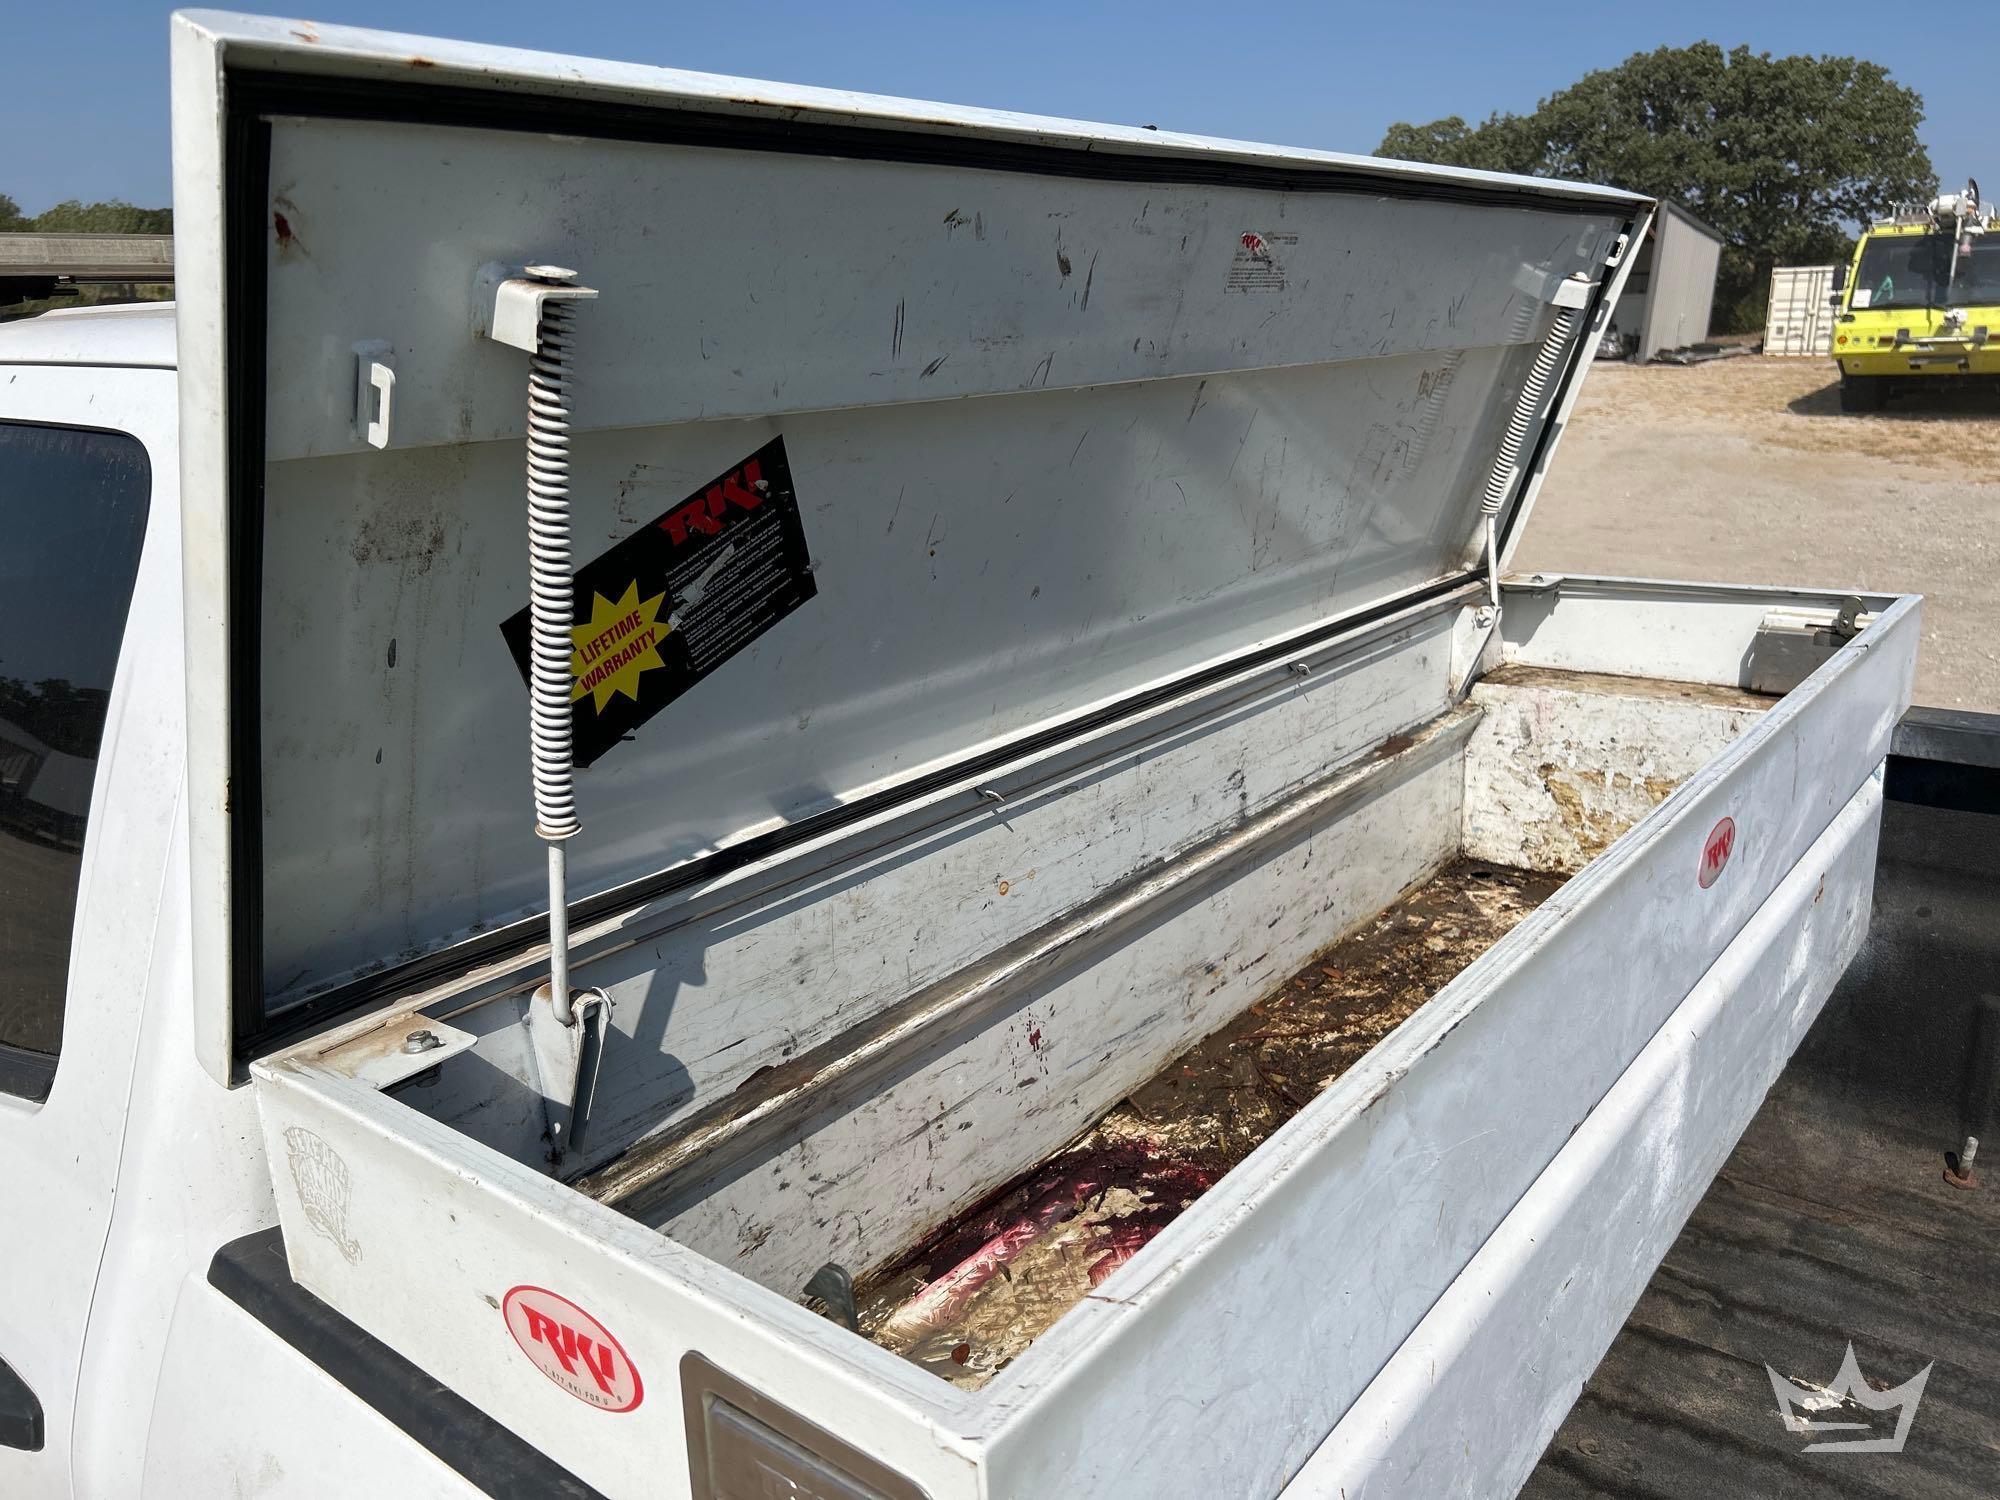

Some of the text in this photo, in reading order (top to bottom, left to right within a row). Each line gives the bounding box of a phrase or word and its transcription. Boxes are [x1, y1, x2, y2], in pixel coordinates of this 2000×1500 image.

[658, 458, 764, 546] RKI
[579, 609, 643, 665] LIFETIME
[580, 627, 656, 692] WARRANTY
[1707, 827, 1731, 869] RKI
[518, 1301, 616, 1398] RKI
